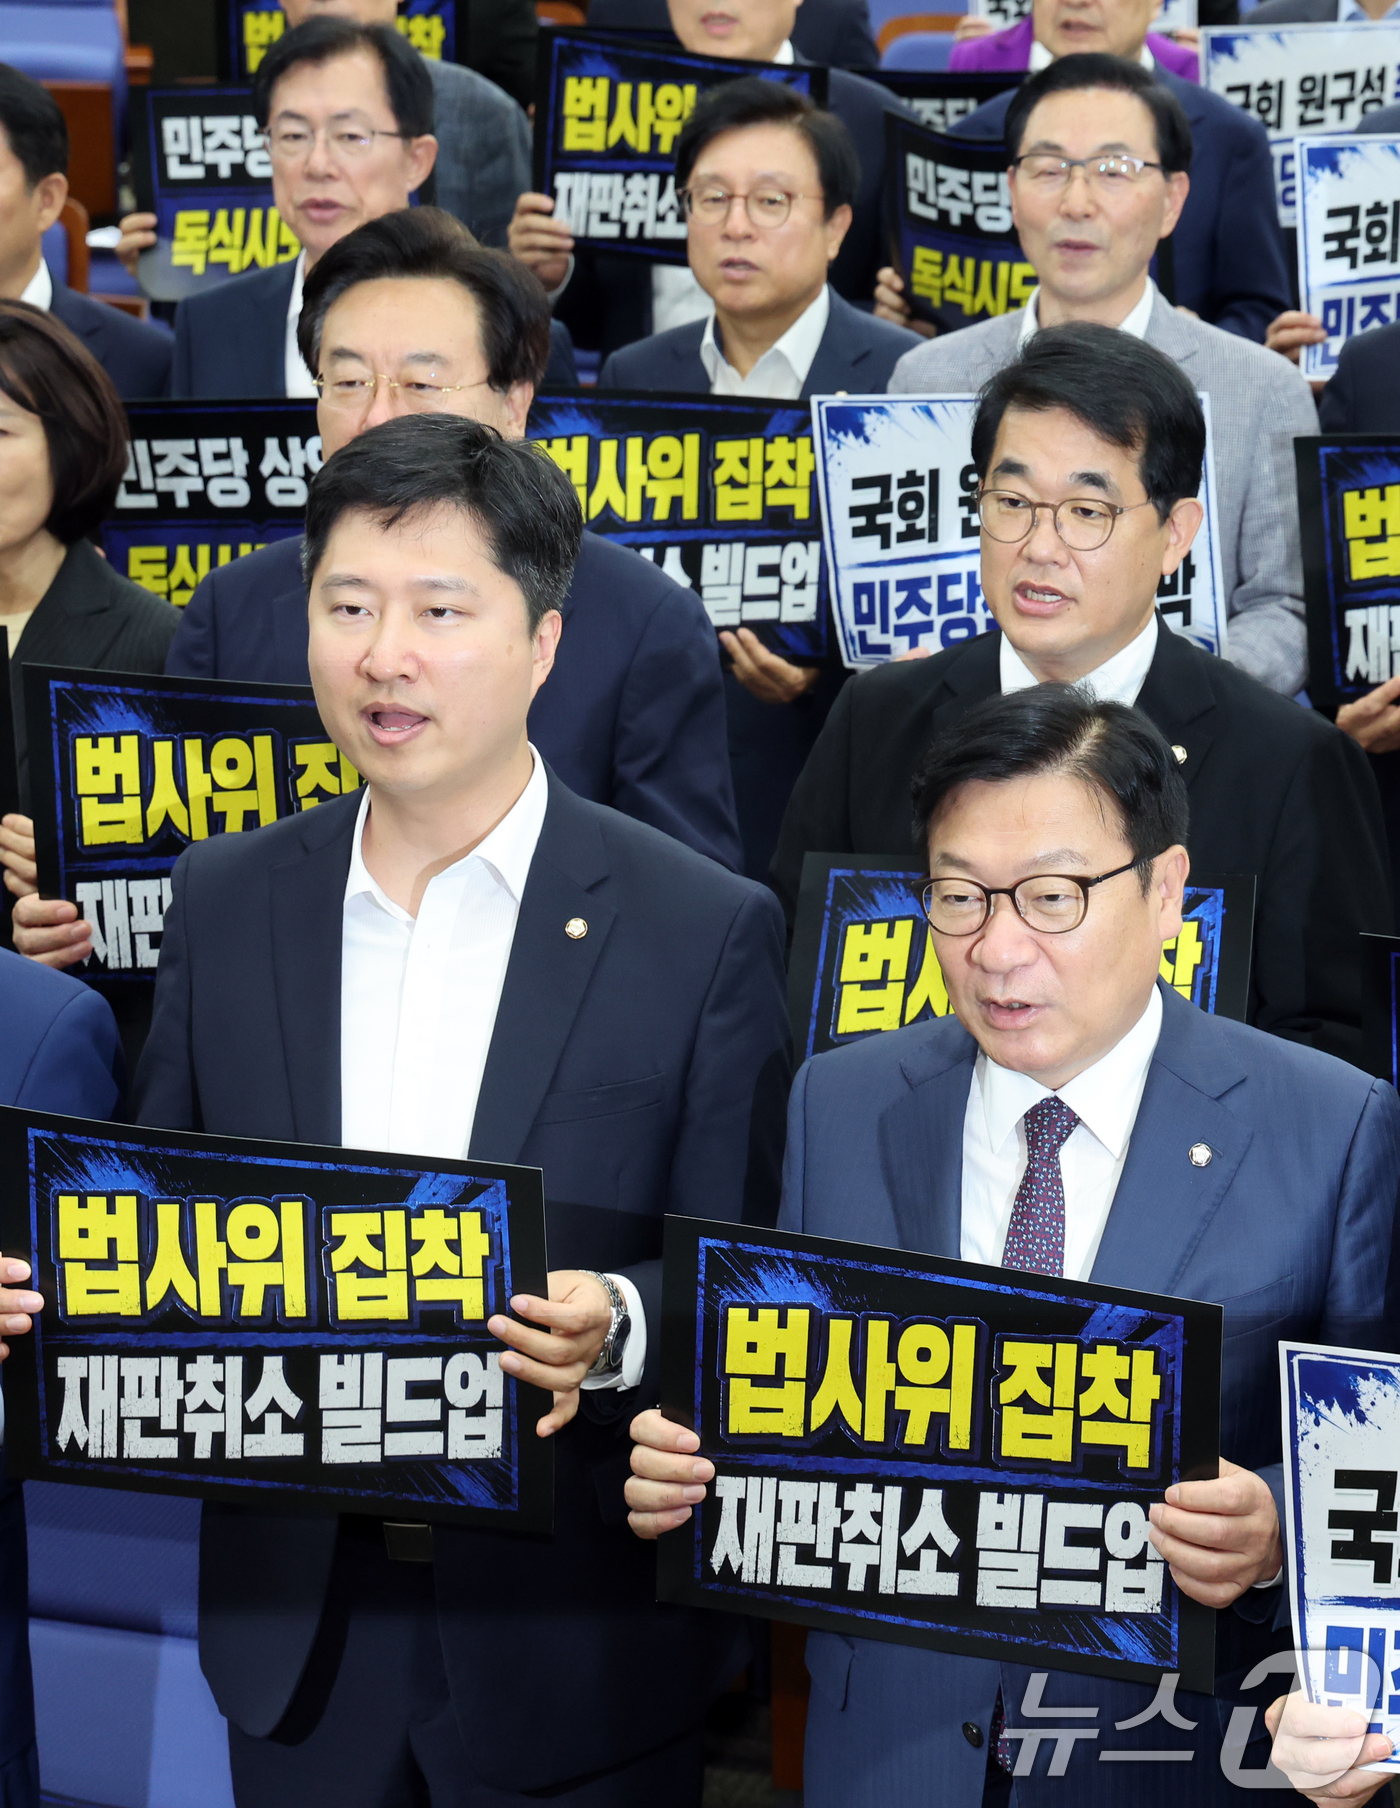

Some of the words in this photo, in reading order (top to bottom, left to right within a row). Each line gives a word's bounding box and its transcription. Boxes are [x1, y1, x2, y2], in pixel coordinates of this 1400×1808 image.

[1298, 66, 1386, 127] 원구성
[906, 153, 1013, 233] 민주당
[1324, 200, 1400, 271] 국회
[713, 436, 815, 521] 집착
[849, 467, 941, 551] 국회
[700, 541, 821, 627] 빌드업
[75, 734, 278, 846] 법사위
[57, 1195, 307, 1318] 법사위
[329, 1209, 490, 1321] 집착
[55, 1353, 304, 1460] 재판취소
[318, 1351, 503, 1465] 빌드업
[724, 1307, 977, 1450] 법사위
[998, 1342, 1162, 1469] 집착
[709, 1475, 961, 1598] 재판취소
[975, 1491, 1165, 1615] 빌드업
